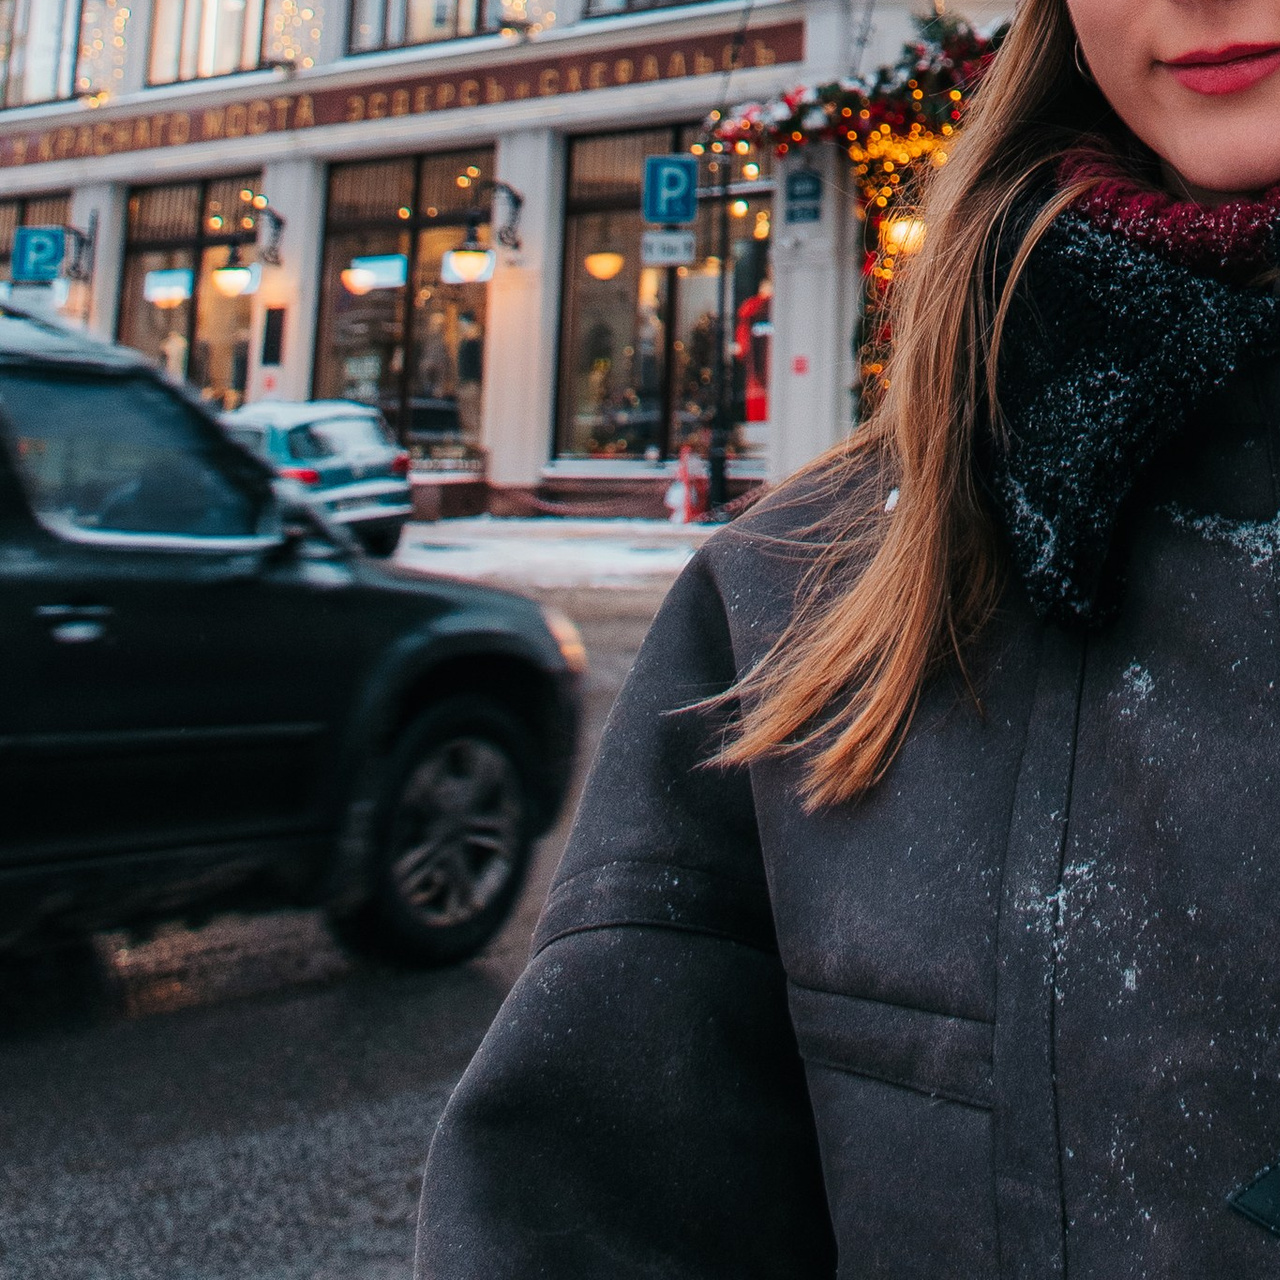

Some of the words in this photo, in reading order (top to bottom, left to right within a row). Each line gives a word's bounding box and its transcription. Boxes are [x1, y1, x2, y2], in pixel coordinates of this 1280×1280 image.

[203, 94, 316, 139] МОСТА
[658, 166, 688, 215] P
[25, 235, 55, 274] P
